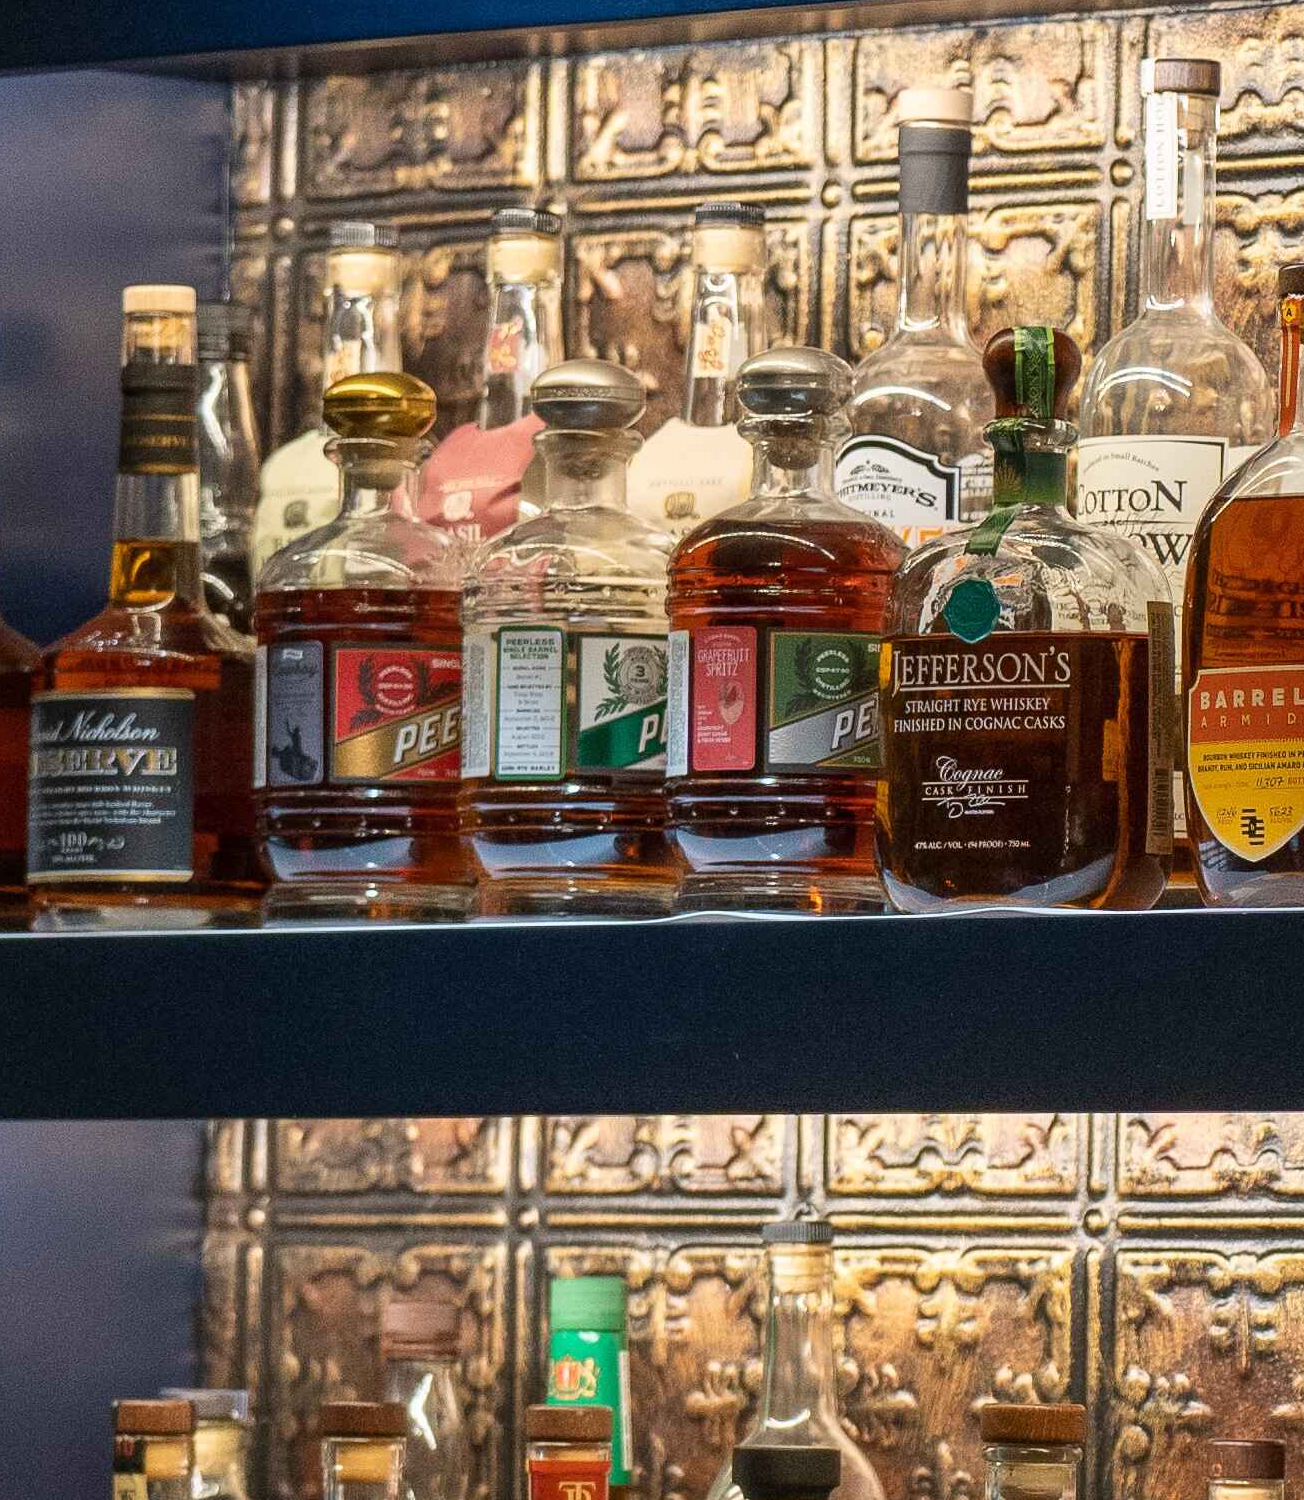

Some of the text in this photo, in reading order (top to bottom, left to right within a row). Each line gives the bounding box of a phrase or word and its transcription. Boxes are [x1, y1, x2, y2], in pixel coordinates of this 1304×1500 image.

[697, 648, 750, 663] GRAPEFRUIT
[705, 661, 738, 678] SPRITZ
[892, 645, 1072, 698] JEFFERSON'S
[905, 697, 1052, 714] STRAIGHT RYE WHISKEY
[63, 710, 161, 742] Nicholson
[893, 716, 1066, 733] FINISHED IN COGNAC CASKS
[1256, 750, 1288, 760] FINISHED
[1288, 750, 1297, 759] IN
[935, 755, 1005, 793] Cognac
[1235, 762, 1248, 771] AND
[1248, 761, 1276, 771] SICILIAN
[1276, 761, 1302, 770] AMARO
[924, 784, 1027, 797] CASK FINISH
